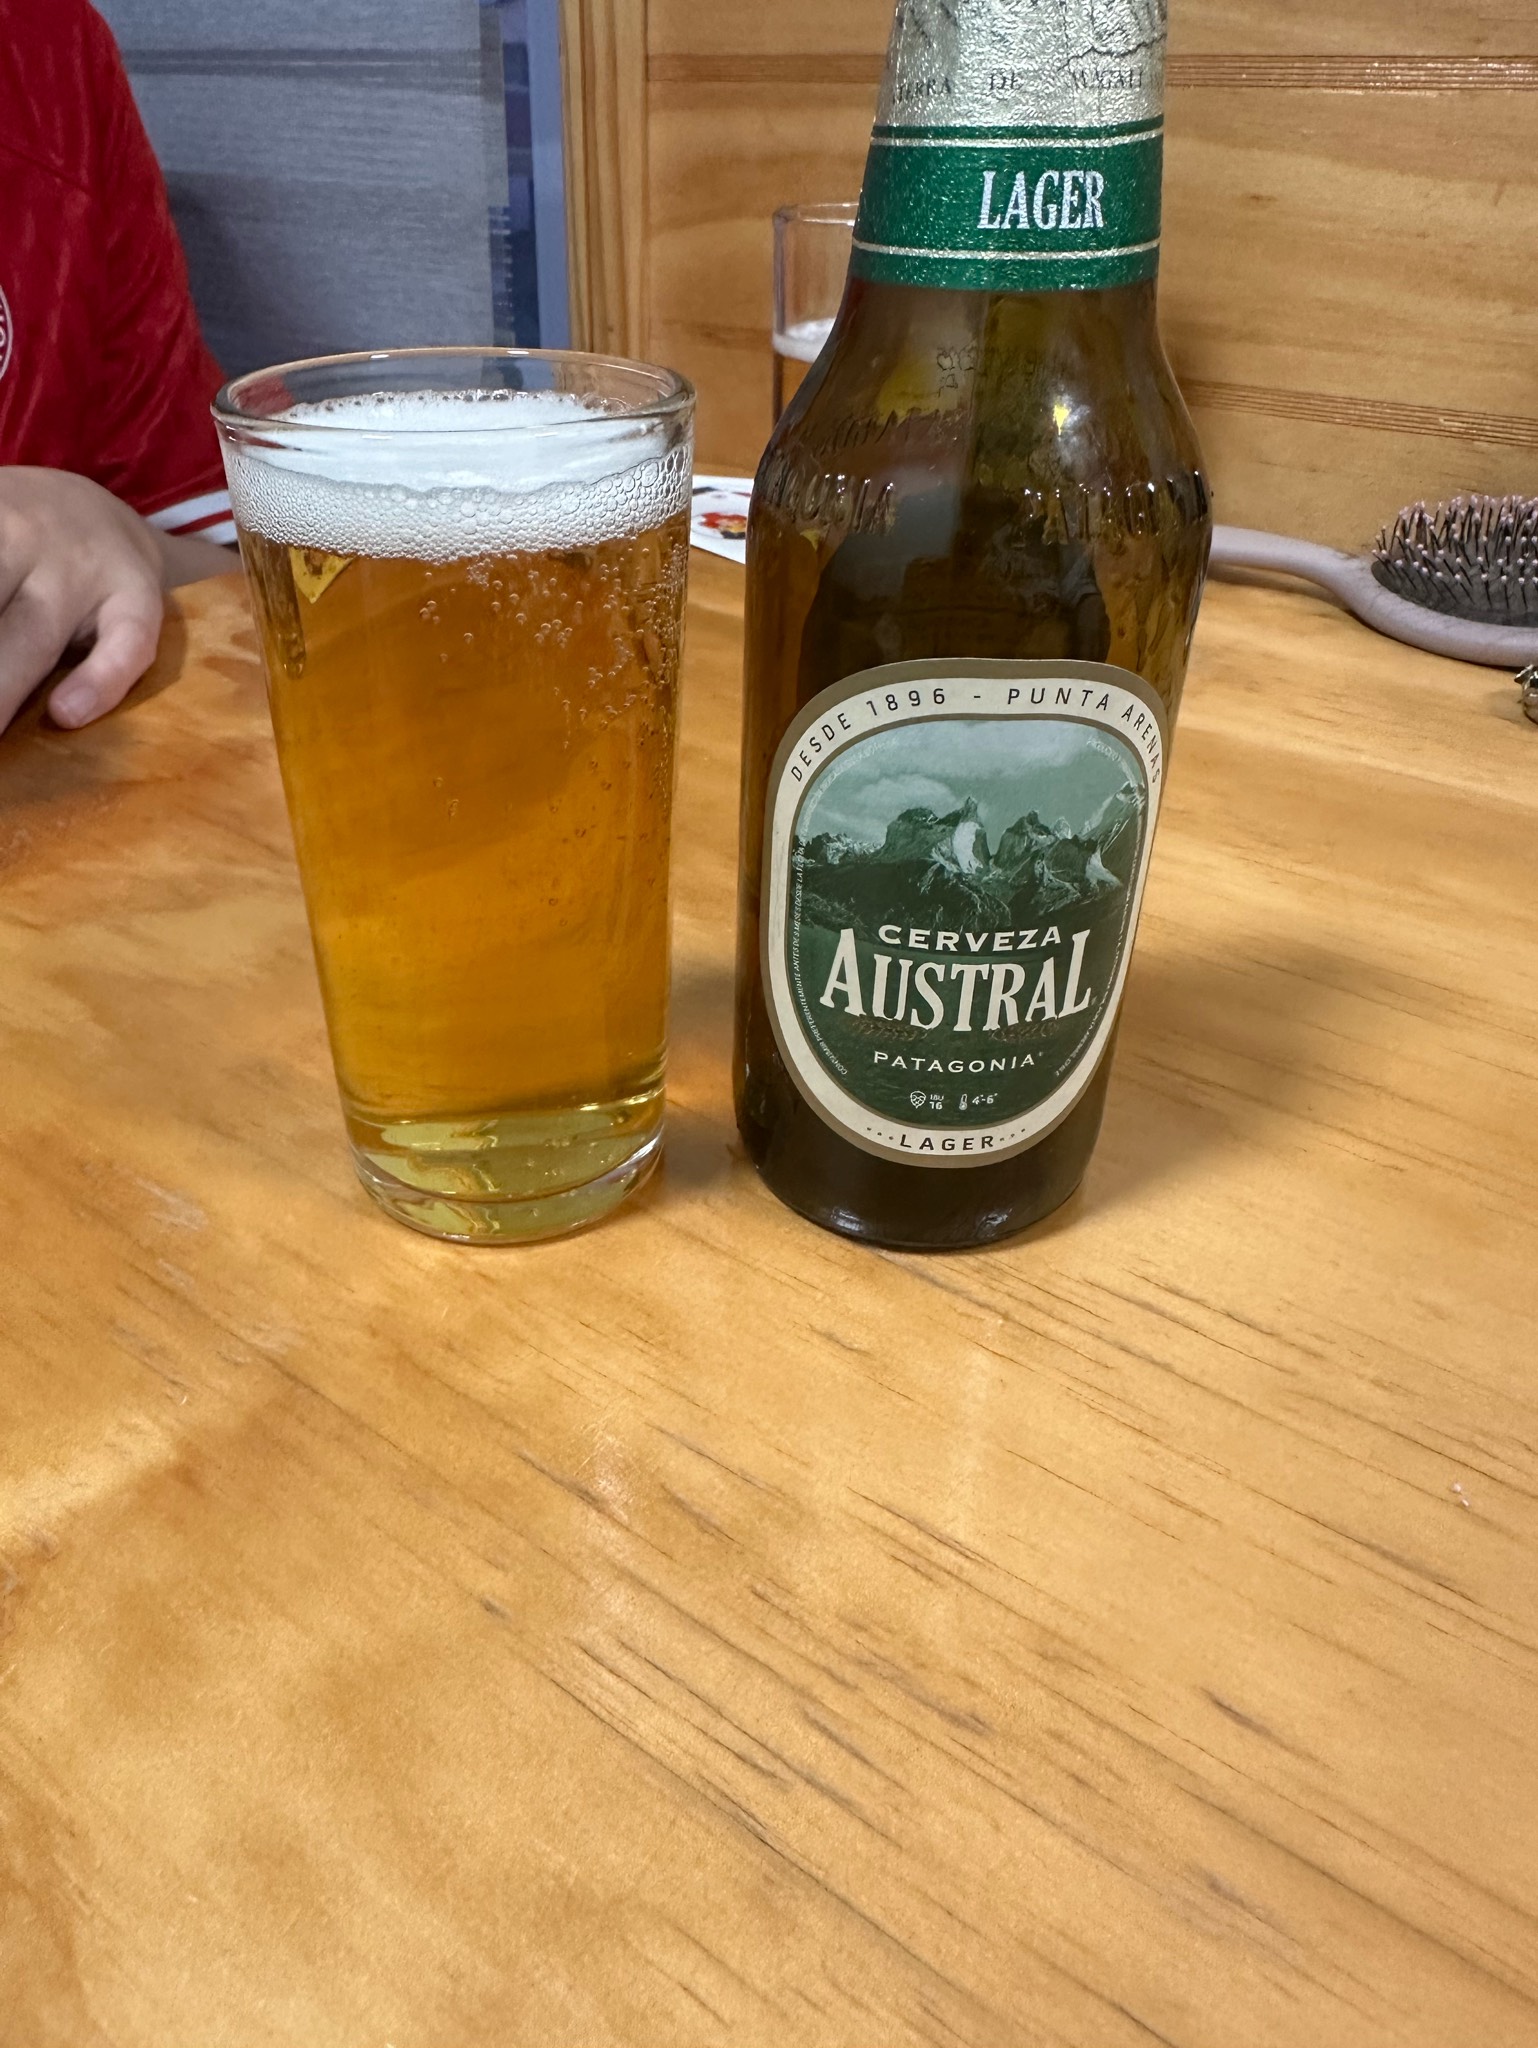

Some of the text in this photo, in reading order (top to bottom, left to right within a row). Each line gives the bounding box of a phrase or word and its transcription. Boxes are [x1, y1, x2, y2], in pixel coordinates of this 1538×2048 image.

[976, 169, 1105, 231] LAGER
[790, 712, 851, 782] DESDE
[866, 687, 946, 716] 1896
[1007, 686, 1110, 711] PUNTA
[1120, 703, 1161, 784] ARENAS
[878, 924, 1062, 953] CERVEZA
[819, 928, 1091, 1032] AUSTRAL
[929, 1101, 943, 1110] 16
[900, 1133, 994, 1151] LAGER
